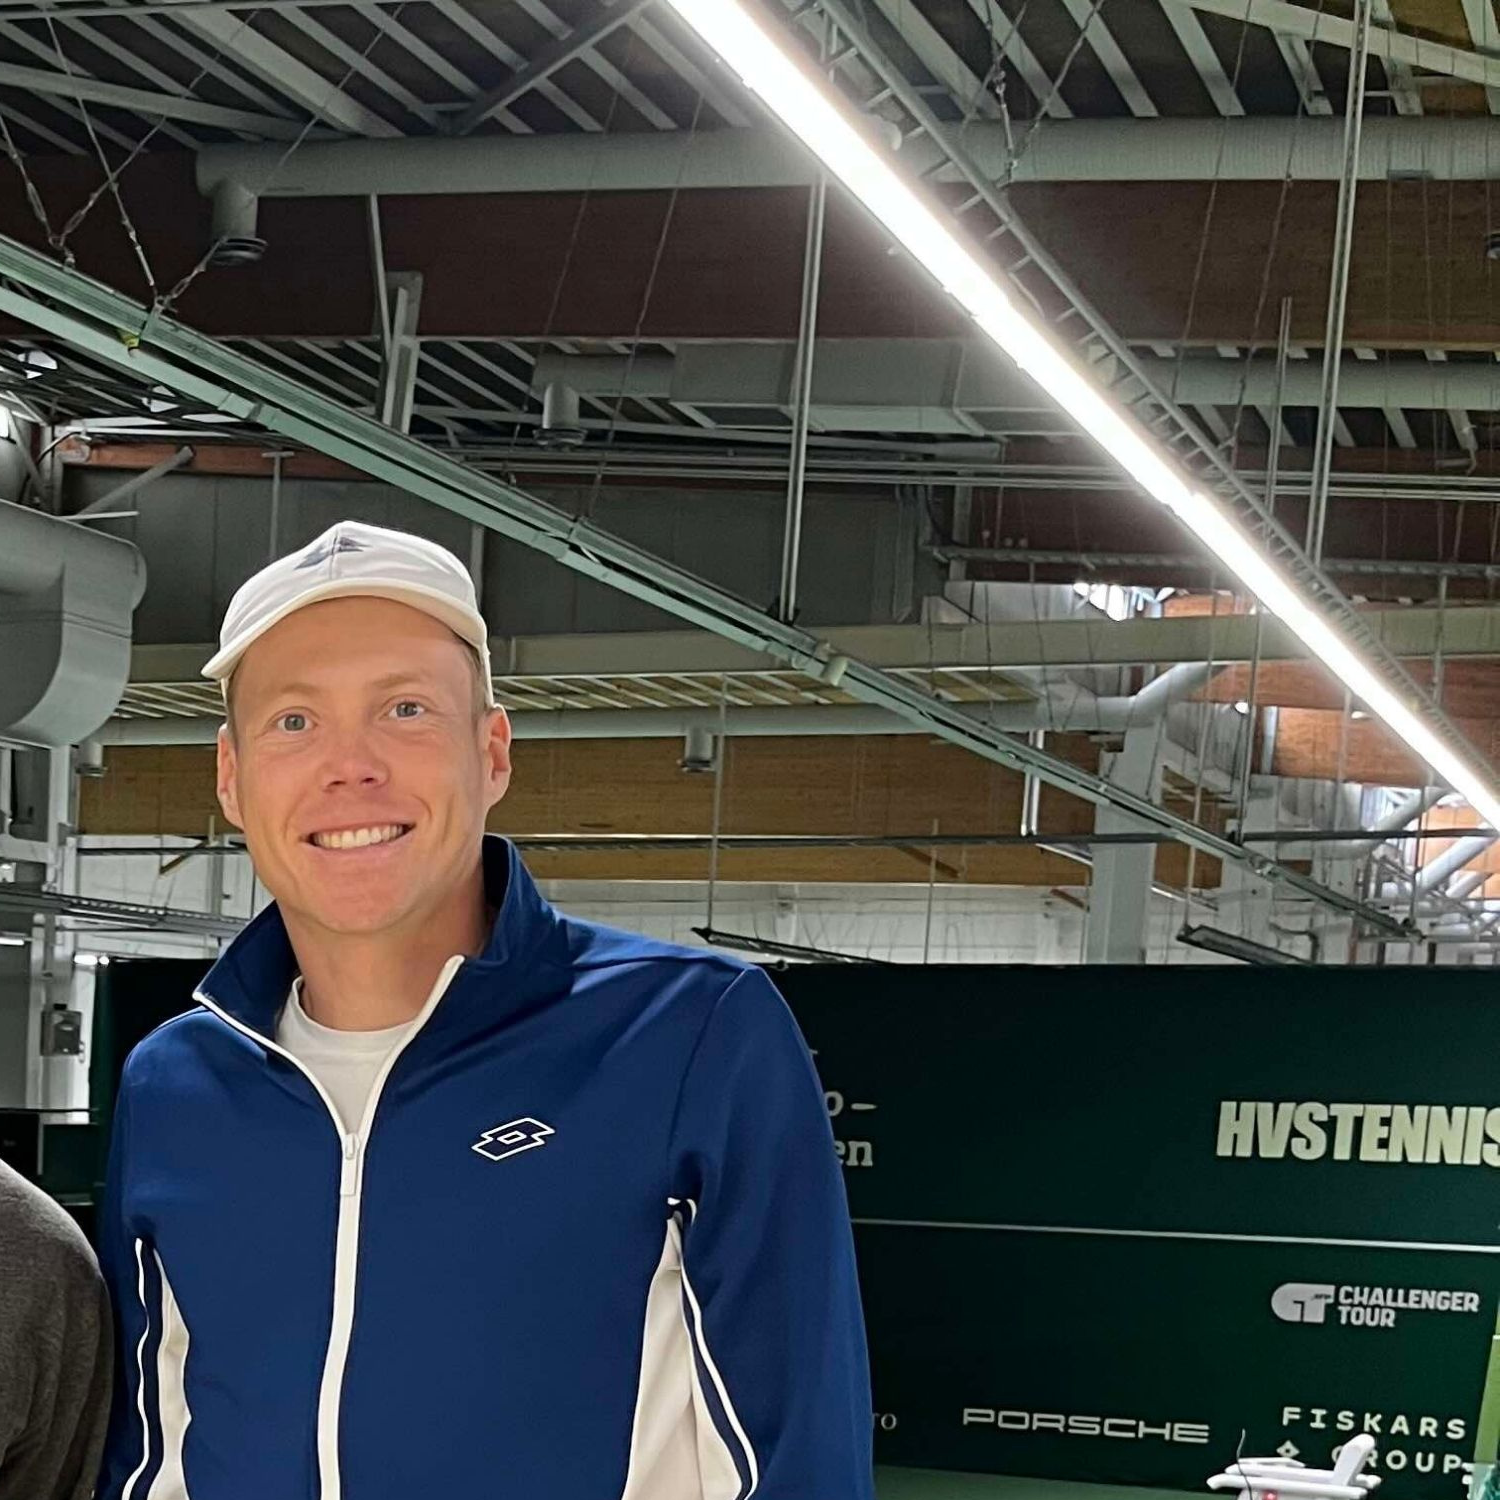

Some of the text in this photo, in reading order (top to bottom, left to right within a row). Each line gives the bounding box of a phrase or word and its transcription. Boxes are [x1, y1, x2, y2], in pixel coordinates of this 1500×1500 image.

[1338, 1286, 1480, 1313] CHALLENGER
[1338, 1306, 1396, 1328] TOUR
[963, 1408, 1210, 1444] PORSCHE
[1282, 1406, 1467, 1440] FISKARS
